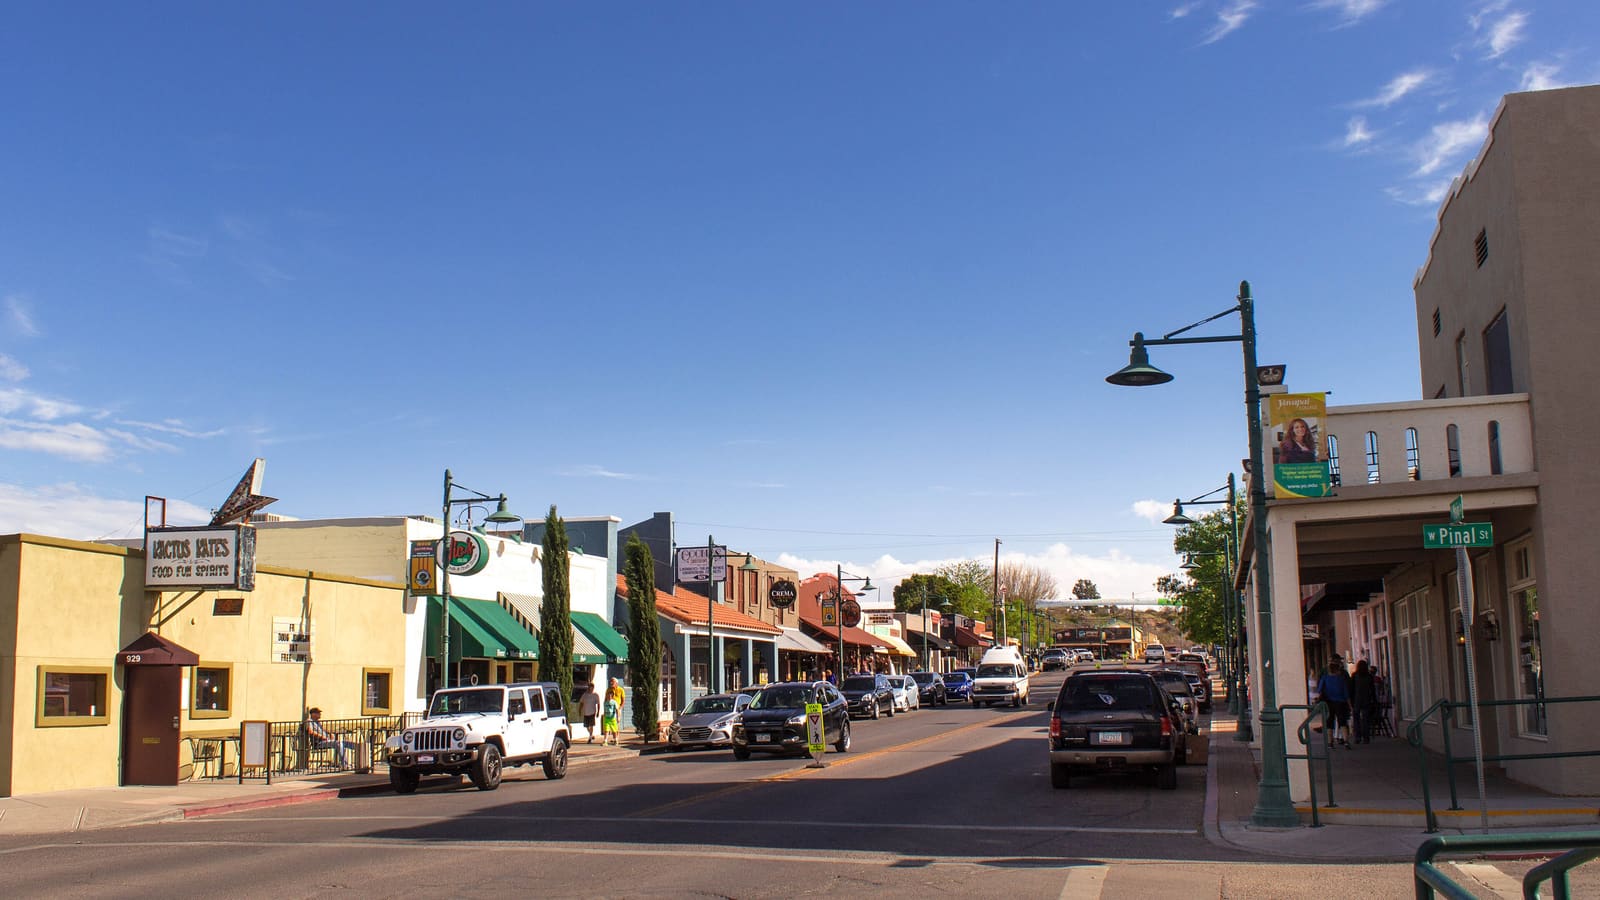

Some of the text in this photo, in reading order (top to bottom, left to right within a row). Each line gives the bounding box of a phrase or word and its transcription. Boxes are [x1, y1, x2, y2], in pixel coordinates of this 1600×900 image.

[1427, 527, 1489, 544] W Pinal St
[152, 537, 230, 559] KACTUS KATES
[152, 564, 229, 578] FOOD FUN SPIRITS
[126, 655, 141, 663] 929
